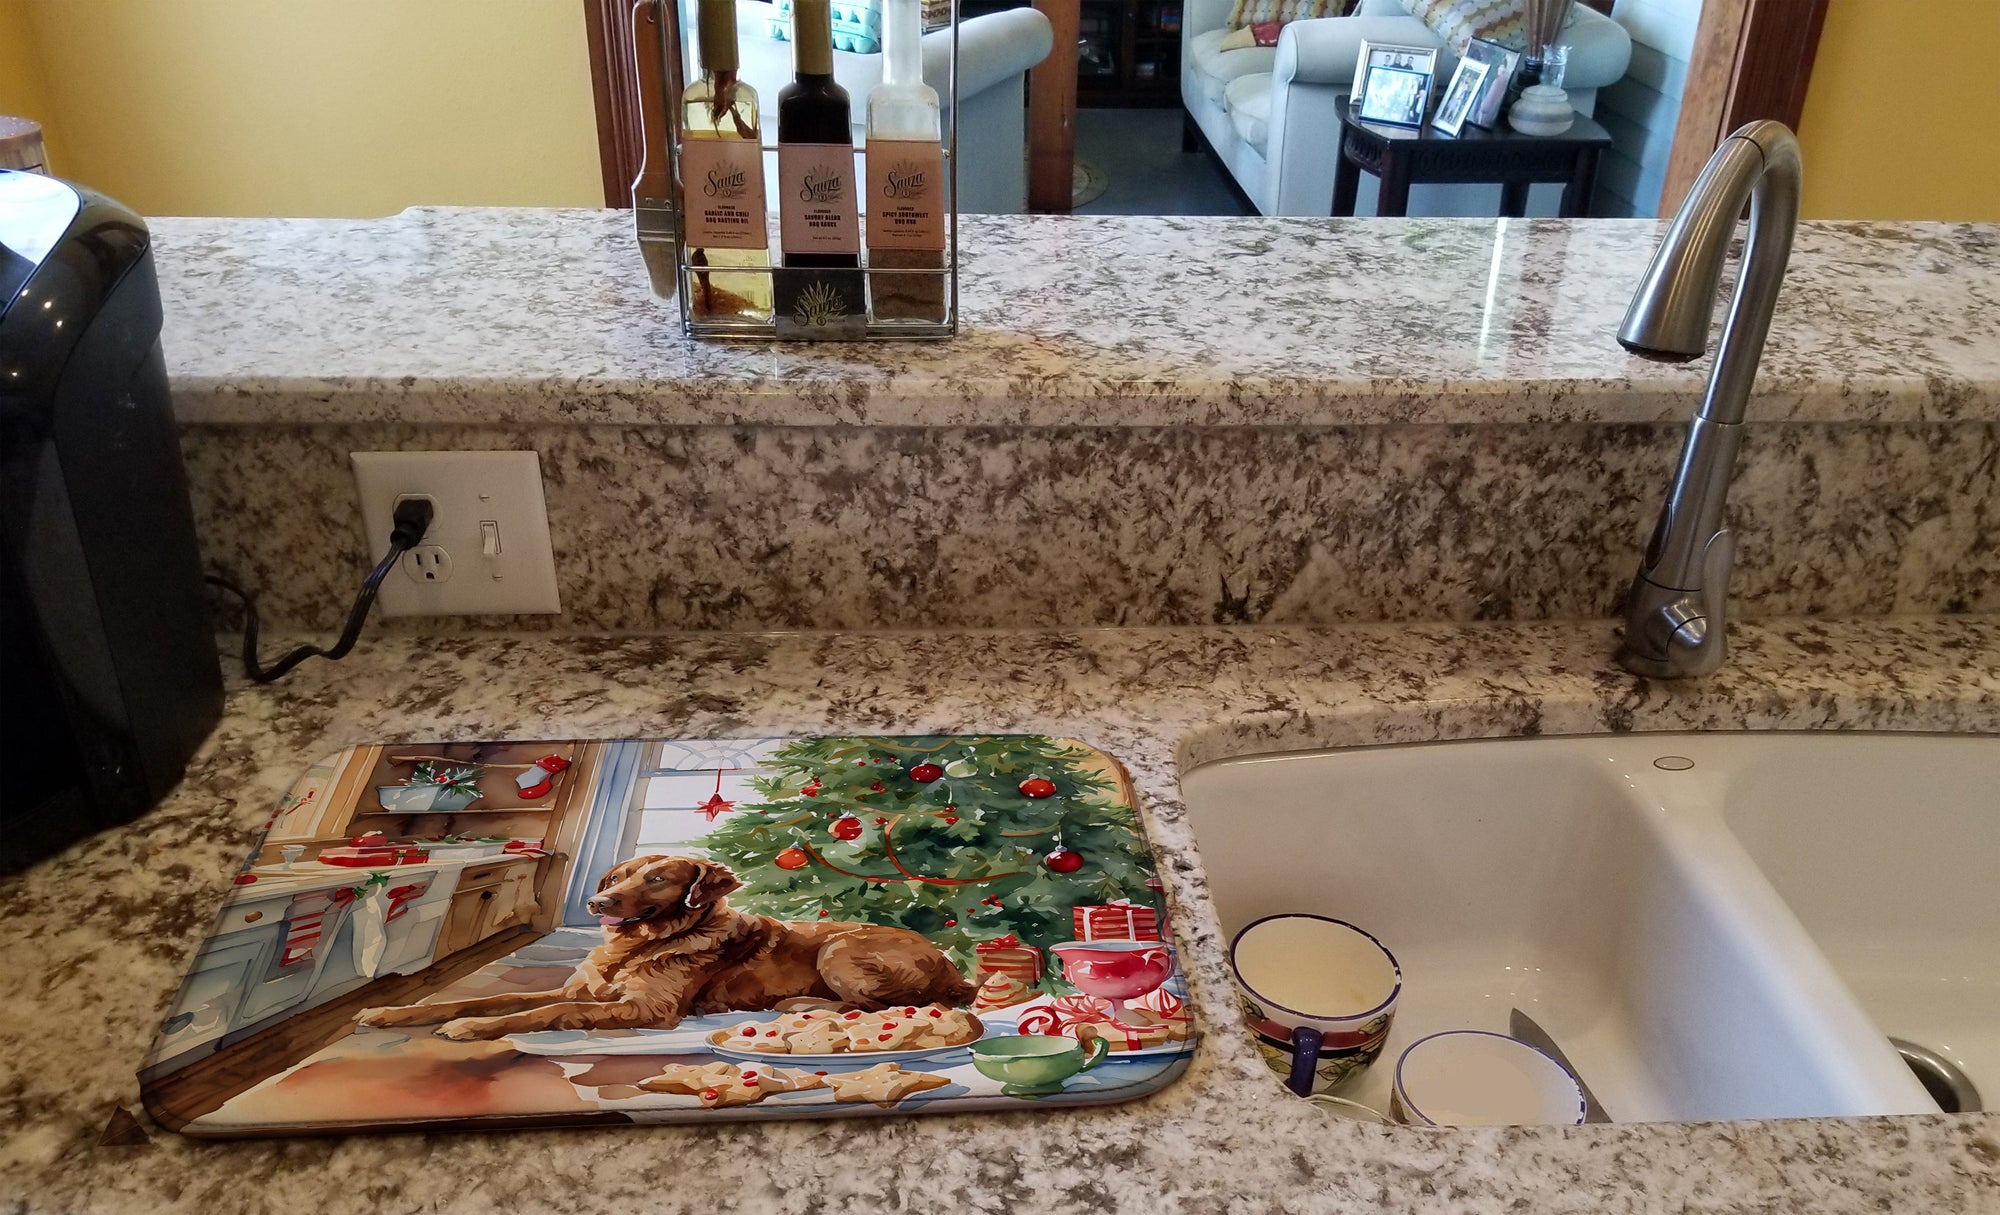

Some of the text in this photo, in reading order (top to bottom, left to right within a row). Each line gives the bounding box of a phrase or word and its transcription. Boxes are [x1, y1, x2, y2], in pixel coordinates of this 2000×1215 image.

[704, 170, 745, 197] Sauza
[800, 175, 841, 202] Sauza
[884, 170, 925, 198] Sauza
[793, 295, 845, 326] Sauza
